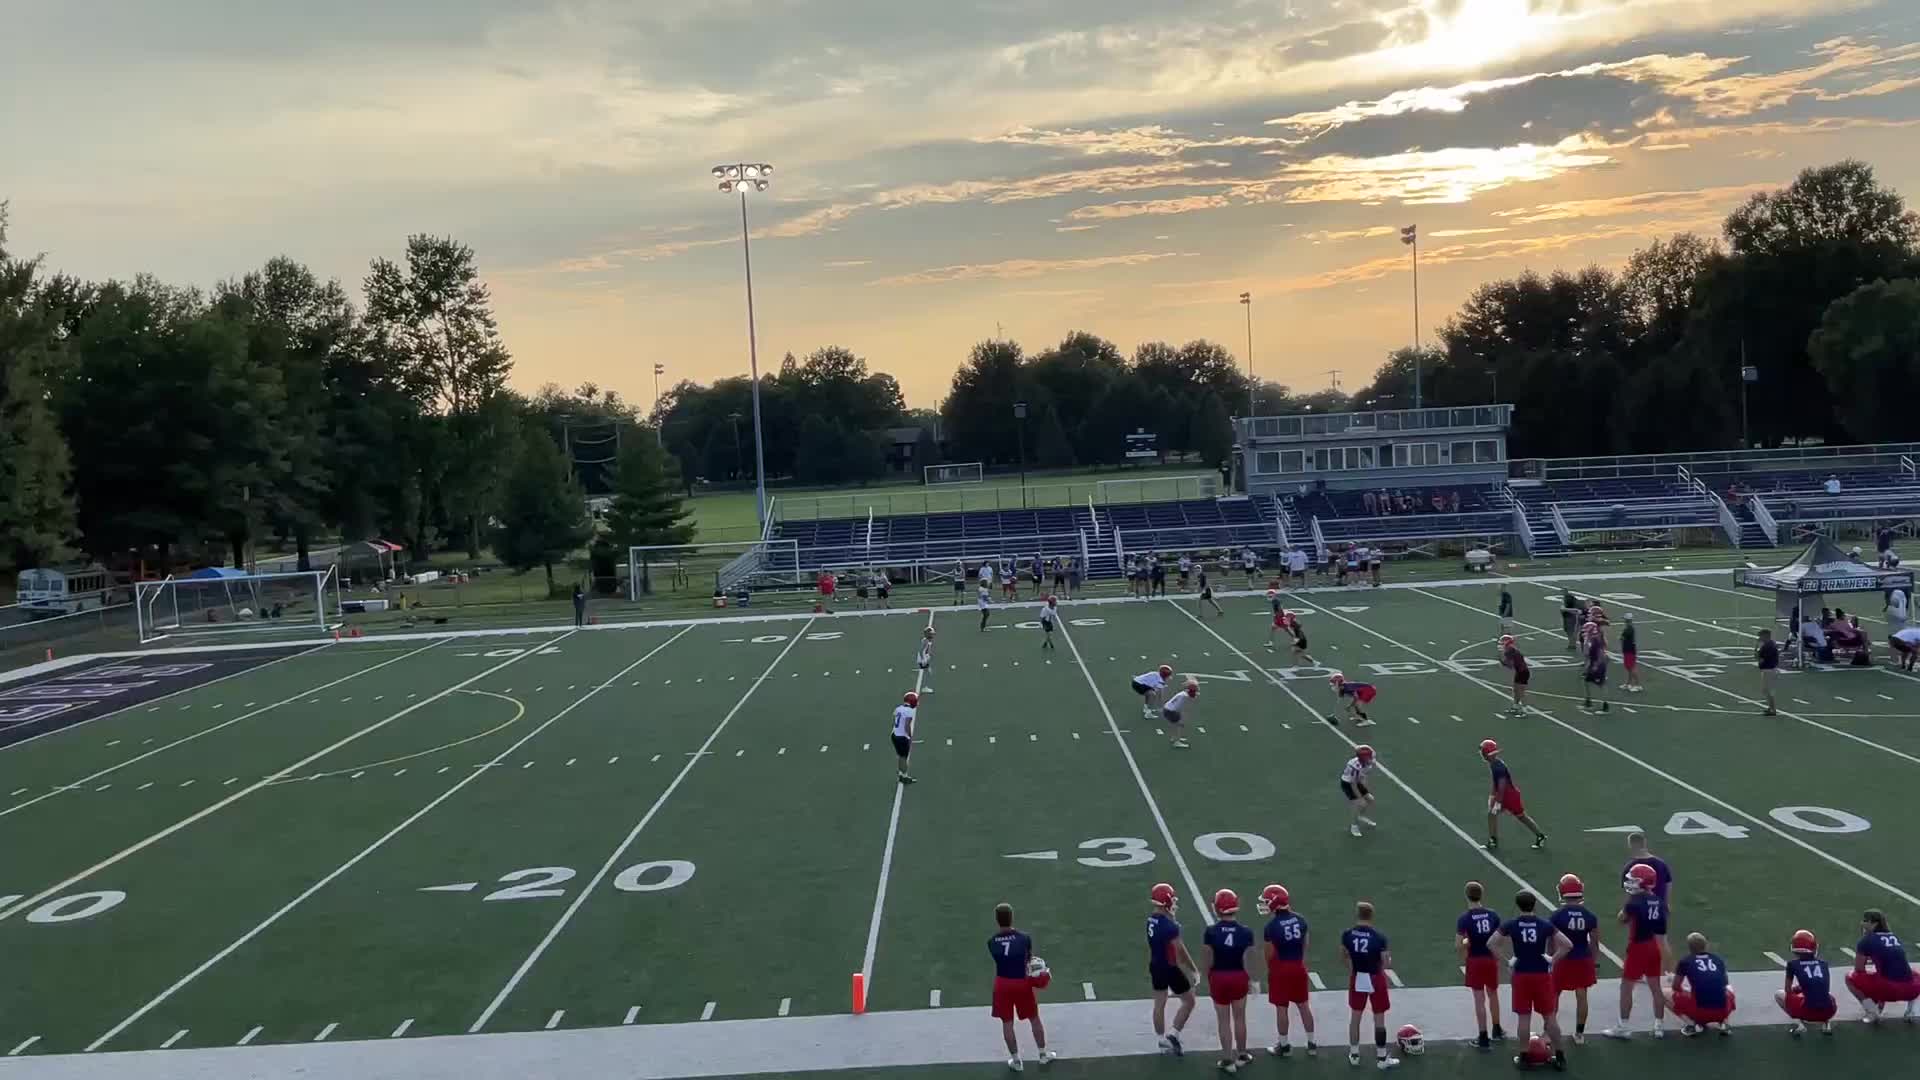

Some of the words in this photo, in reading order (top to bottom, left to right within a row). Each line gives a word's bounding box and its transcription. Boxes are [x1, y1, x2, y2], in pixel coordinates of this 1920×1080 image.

[1803, 579, 1819, 591] GO
[1820, 577, 1877, 591] PANTHERS
[1647, 906, 1659, 920] 16
[1148, 923, 1156, 937] 5
[1476, 919, 1490, 934] 18
[1568, 918, 1585, 930] 40
[1284, 923, 1302, 941] 55
[1521, 928, 1537, 943] 13
[1224, 933, 1233, 946] 4
[1352, 938, 1369, 953] 12
[1880, 935, 1901, 947] 22
[1001, 942, 1011, 956] 7
[1695, 959, 1717, 972] 36
[1803, 965, 1823, 979] 14
